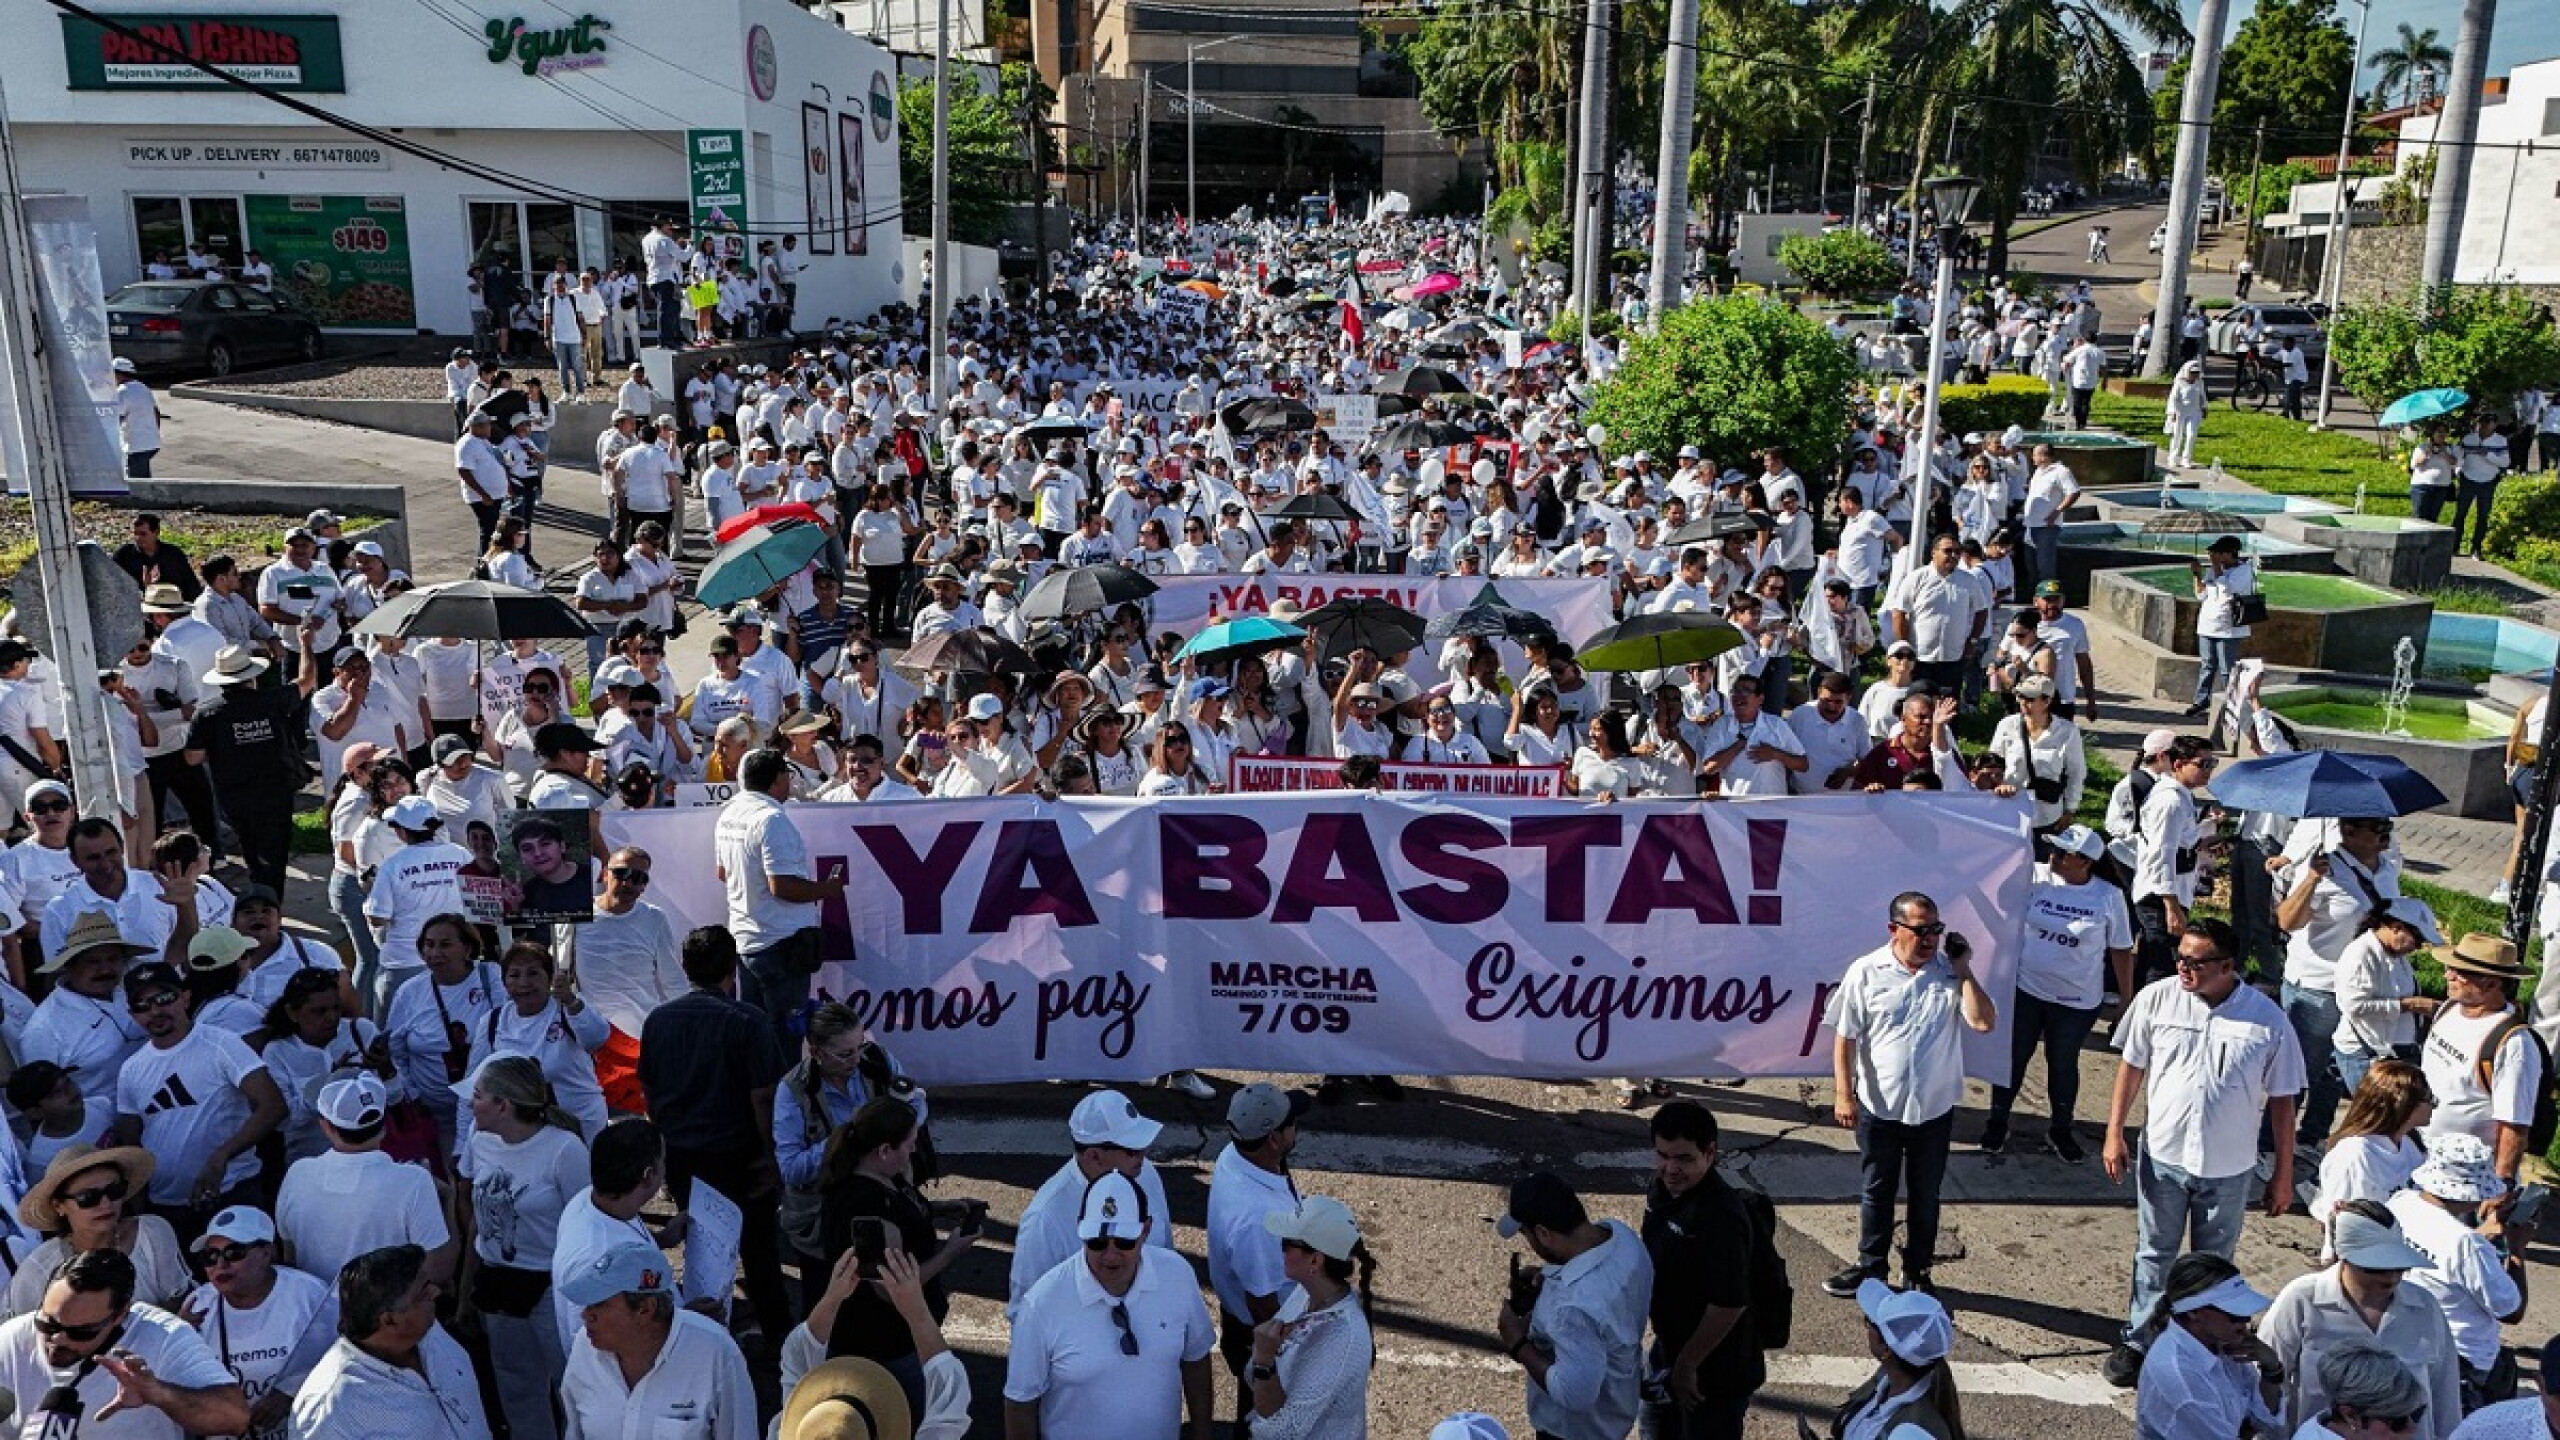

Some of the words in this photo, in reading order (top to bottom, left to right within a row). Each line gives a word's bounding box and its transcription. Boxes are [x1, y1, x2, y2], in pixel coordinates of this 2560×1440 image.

[107, 67, 152, 79] Mejores
[130, 147, 167, 161] PICK
[171, 147, 192, 161] UP
[205, 147, 280, 161] DELIVERY
[293, 148, 381, 163] 6671478009
[334, 228, 387, 251] $149
[1209, 584, 1269, 618] ¡YA
[232, 719, 269, 731] Portal
[235, 726, 273, 739] Capital
[704, 784, 733, 801] YO
[816, 818, 1099, 961] ¡YA
[1160, 812, 1787, 926] BASTA!
[2039, 927, 2079, 948] 7/09
[1211, 961, 1378, 992] MARCHA
[1035, 969, 1150, 1061] paz
[1465, 941, 1792, 1061] Exigimos
[1211, 989, 1268, 999] DOMINGO
[1271, 989, 1279, 999] 7
[1282, 989, 1300, 999] DE
[1303, 990, 1378, 1003] SEPTIEMBRE
[1238, 1003, 1351, 1034] 7/09
